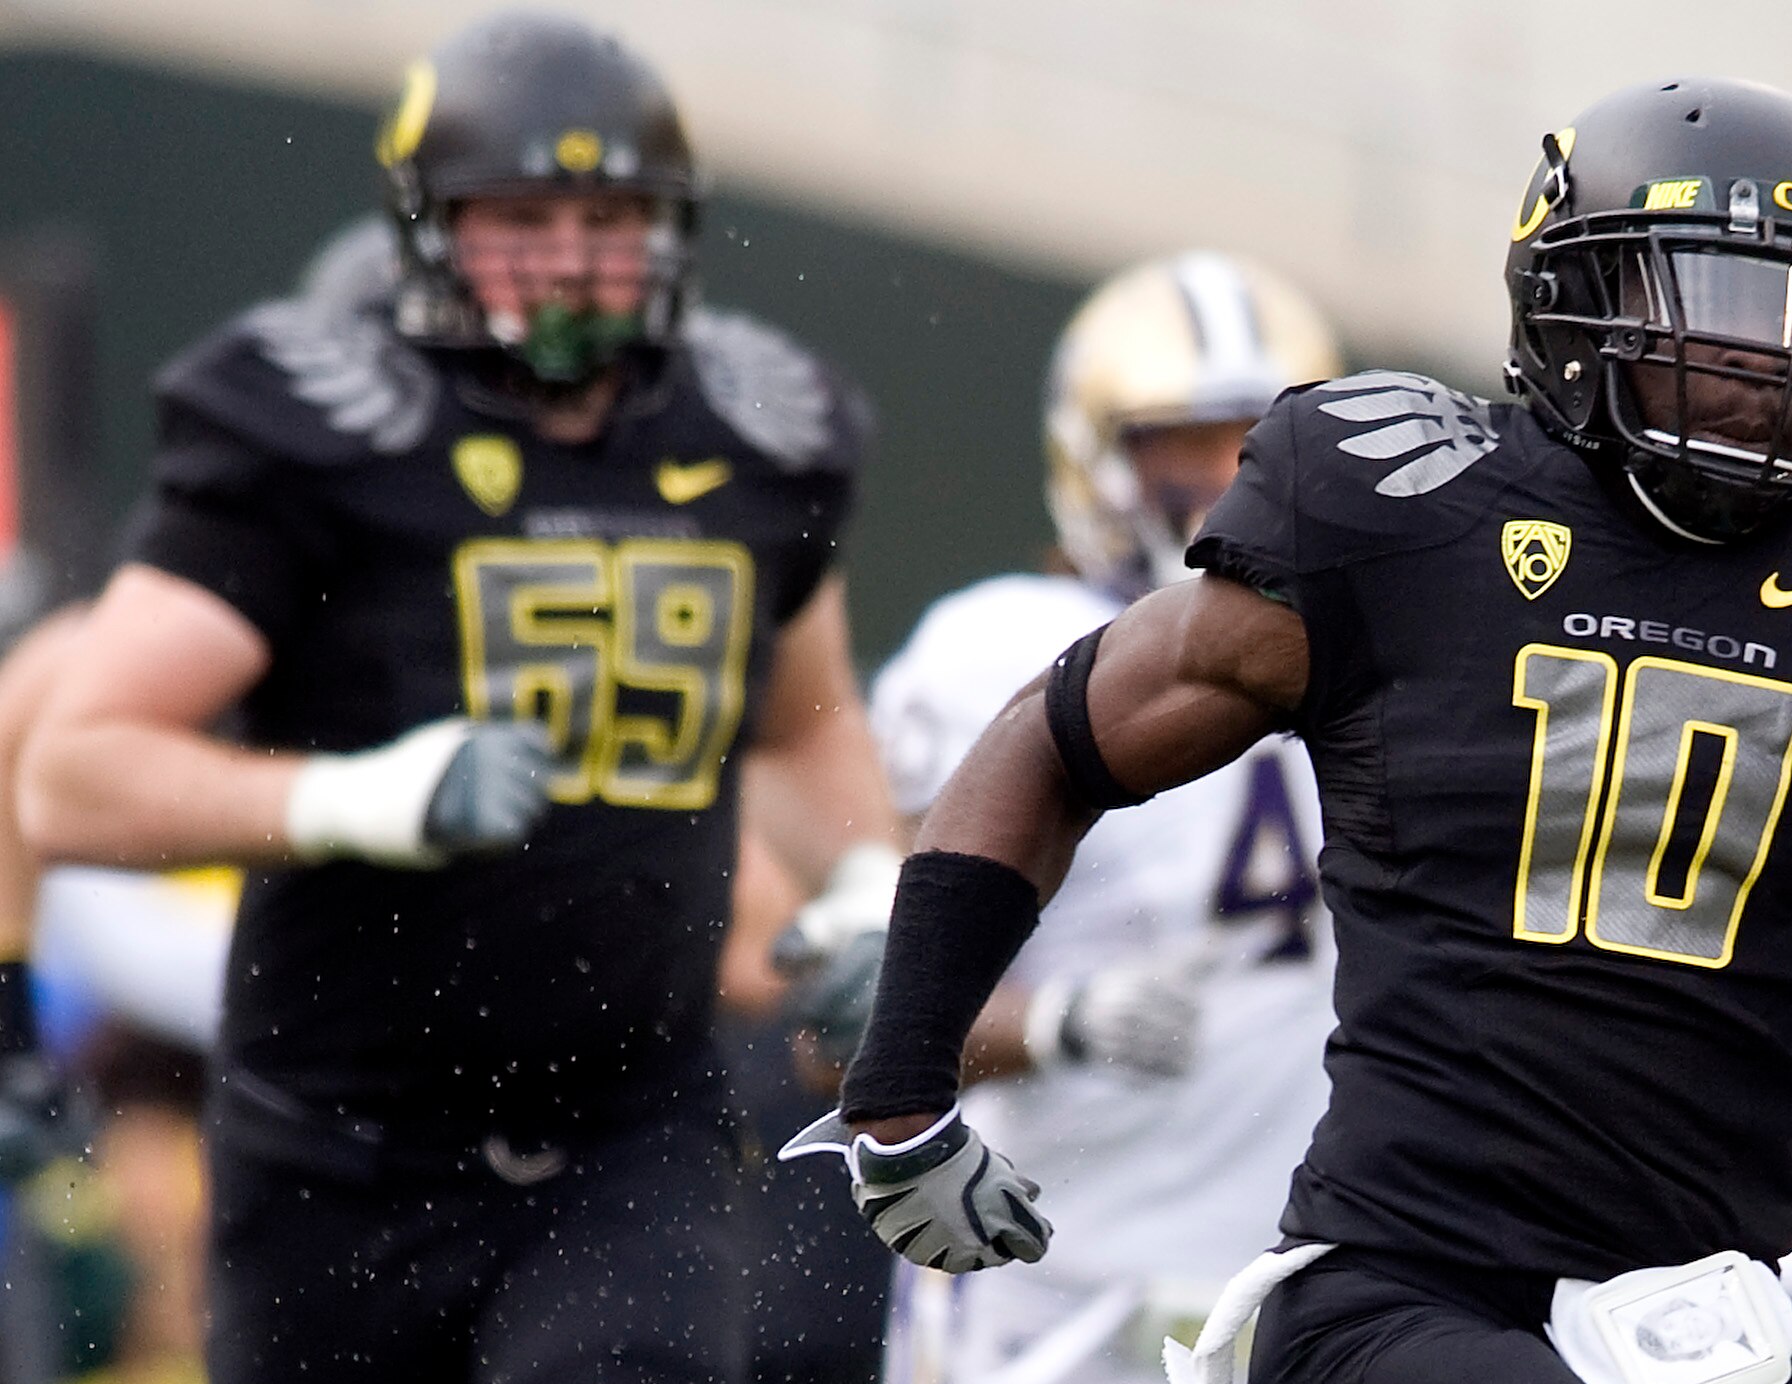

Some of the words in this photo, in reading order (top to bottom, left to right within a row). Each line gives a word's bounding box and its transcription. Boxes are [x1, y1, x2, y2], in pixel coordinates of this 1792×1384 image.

[1644, 180, 1702, 210] NIKE
[1506, 525, 1567, 569] PAC
[1518, 552, 1554, 582] 10
[1563, 612, 1777, 669] OREGON
[452, 538, 757, 811] 69
[1208, 752, 1319, 967] 4
